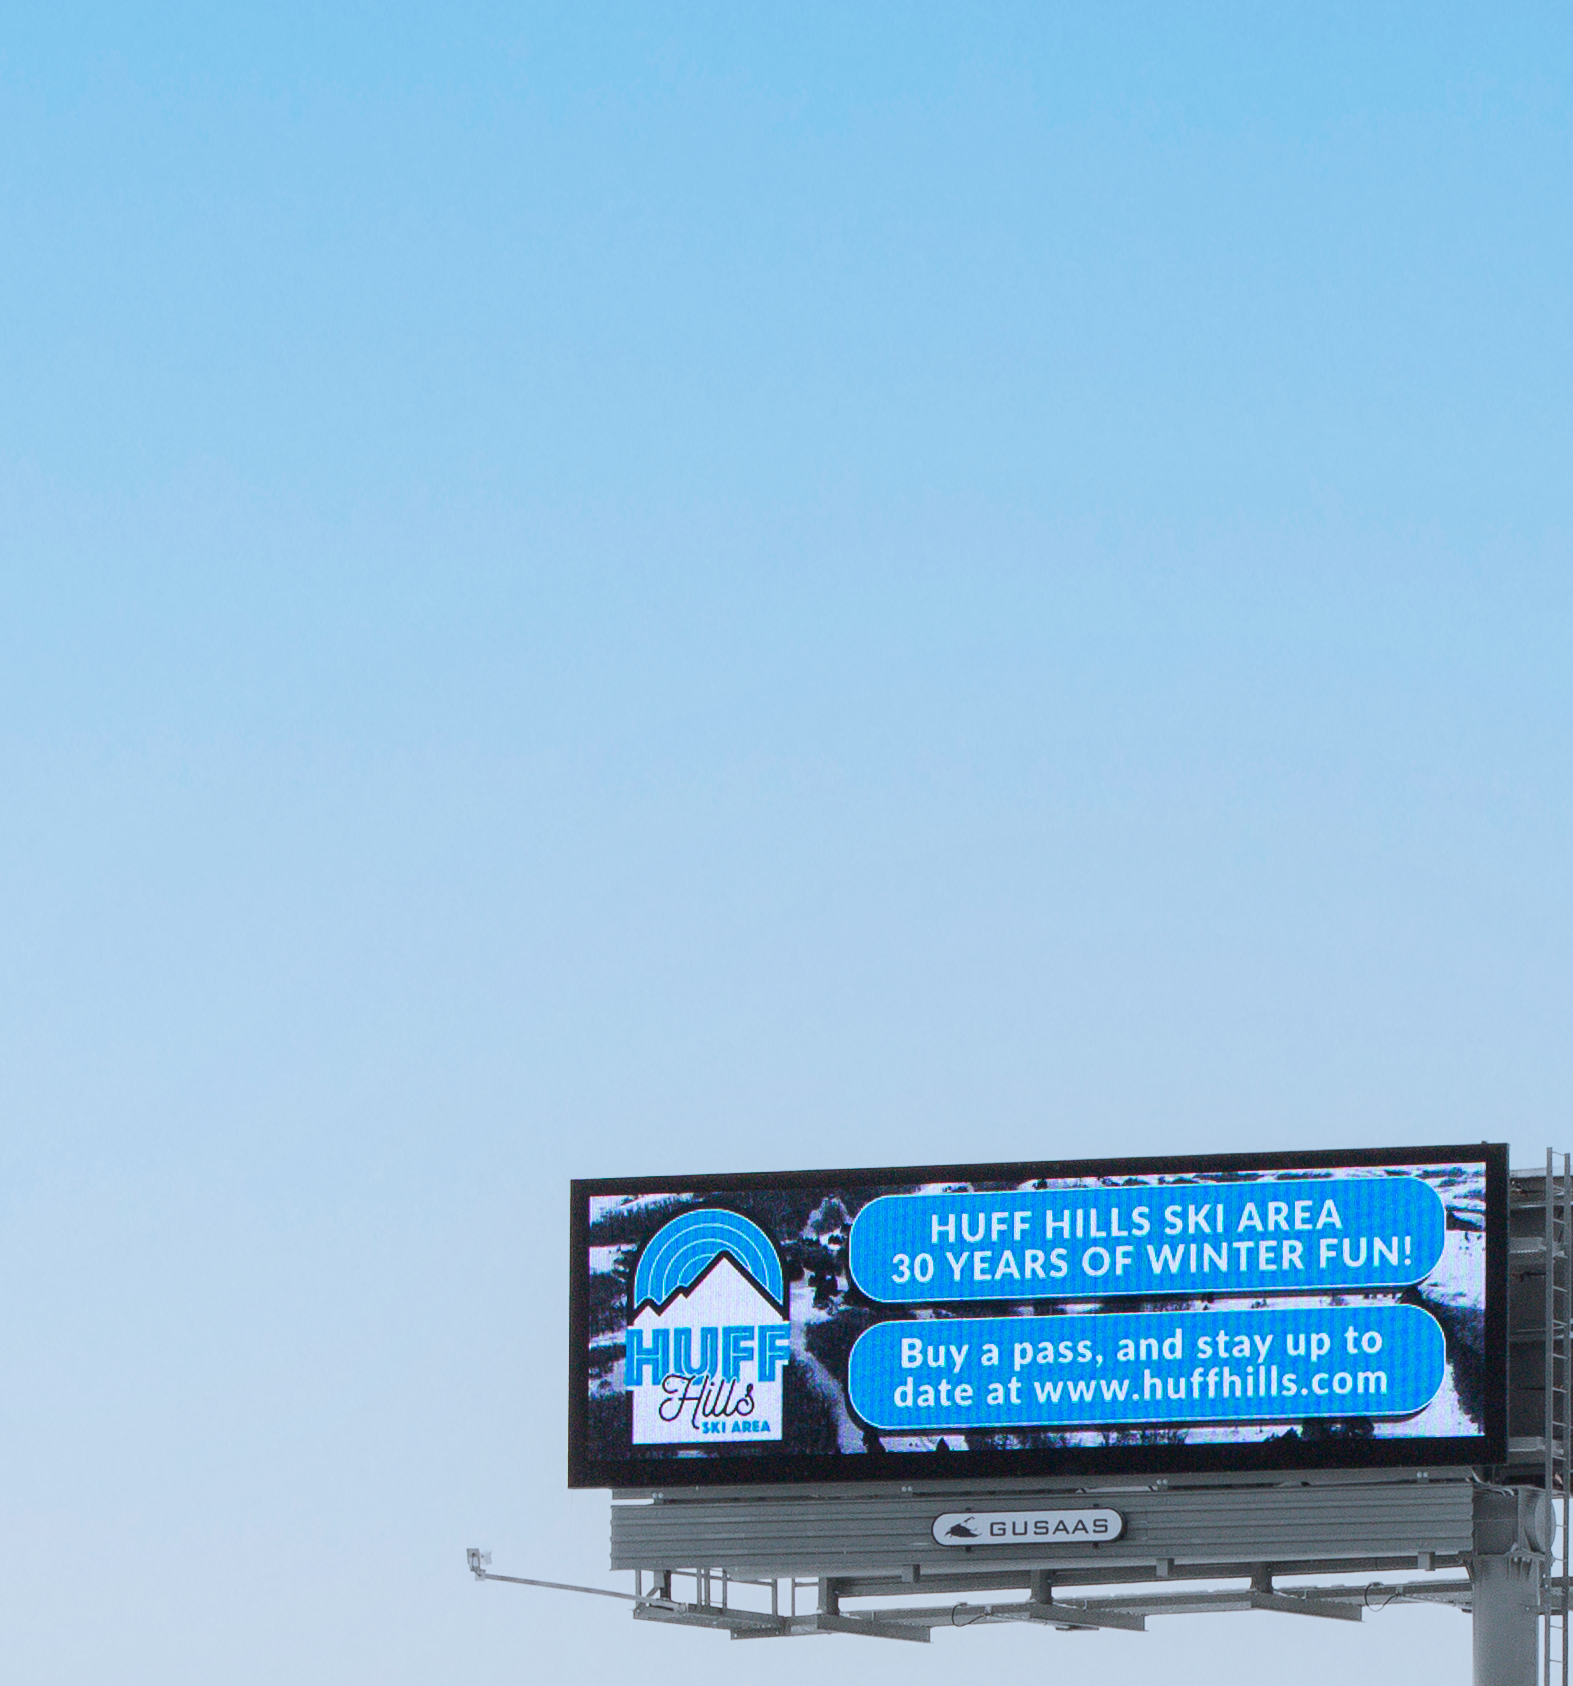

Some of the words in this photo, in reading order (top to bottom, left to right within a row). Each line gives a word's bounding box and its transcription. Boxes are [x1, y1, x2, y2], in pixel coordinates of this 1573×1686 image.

[931, 1211, 1032, 1244] HUFF
[1045, 1206, 1151, 1239] HILLS
[1164, 1203, 1224, 1235] SKI
[1236, 1199, 1343, 1233] AREA
[891, 1252, 935, 1285] 30
[945, 1247, 1068, 1283] YEARS
[1081, 1245, 1134, 1277] OF
[1146, 1239, 1305, 1275] WINTER
[1319, 1236, 1412, 1269] FUN!
[624, 1324, 791, 1386] HUFF
[900, 1337, 969, 1374] Buy
[980, 1343, 999, 1366] a
[1013, 1339, 1103, 1372] pass,
[1116, 1328, 1183, 1362] and
[1196, 1330, 1274, 1364] stay
[1286, 1332, 1331, 1363] up
[1344, 1325, 1383, 1355] to
[658, 1373, 755, 1430] Hills
[893, 1376, 974, 1408] date
[987, 1376, 1022, 1406] at
[1033, 1365, 1388, 1403] www.huffhills.com
[701, 1421, 726, 1434] SKI
[731, 1420, 771, 1433] AREA
[990, 1518, 1109, 1537] GUSAAS
